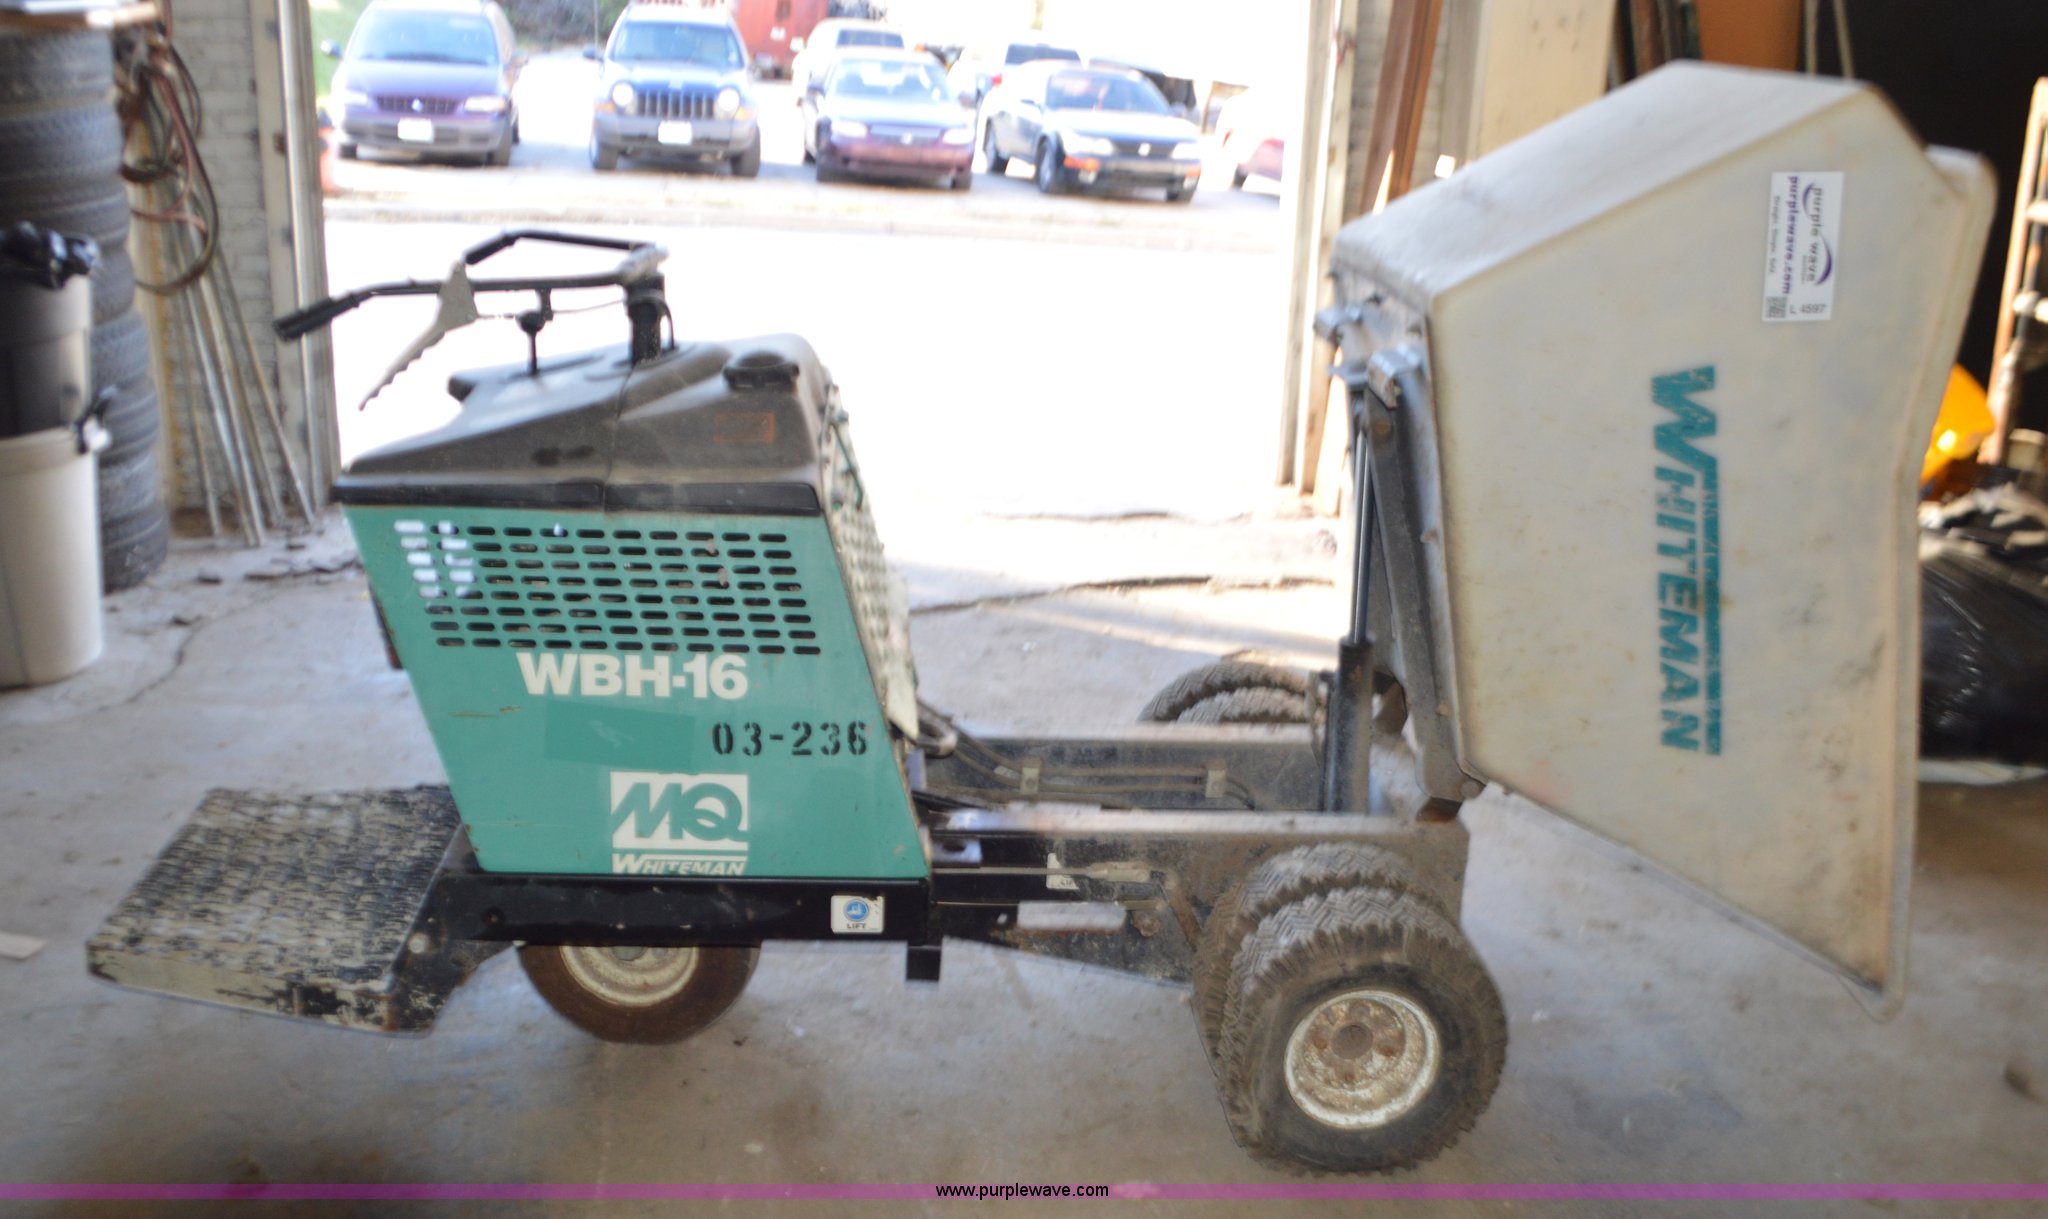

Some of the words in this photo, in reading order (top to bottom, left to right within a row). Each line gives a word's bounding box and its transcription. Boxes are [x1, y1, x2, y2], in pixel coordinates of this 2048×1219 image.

[1782, 176, 1799, 294] purplewave.com
[1809, 187, 1823, 237] purple
[1807, 242, 1819, 282] wave
[1650, 365, 1721, 756] WHITEMAN
[516, 652, 748, 699] WBH-16
[712, 721, 868, 756] 03-236
[611, 781, 748, 841] MQ
[612, 853, 747, 875] WHITEMAN
